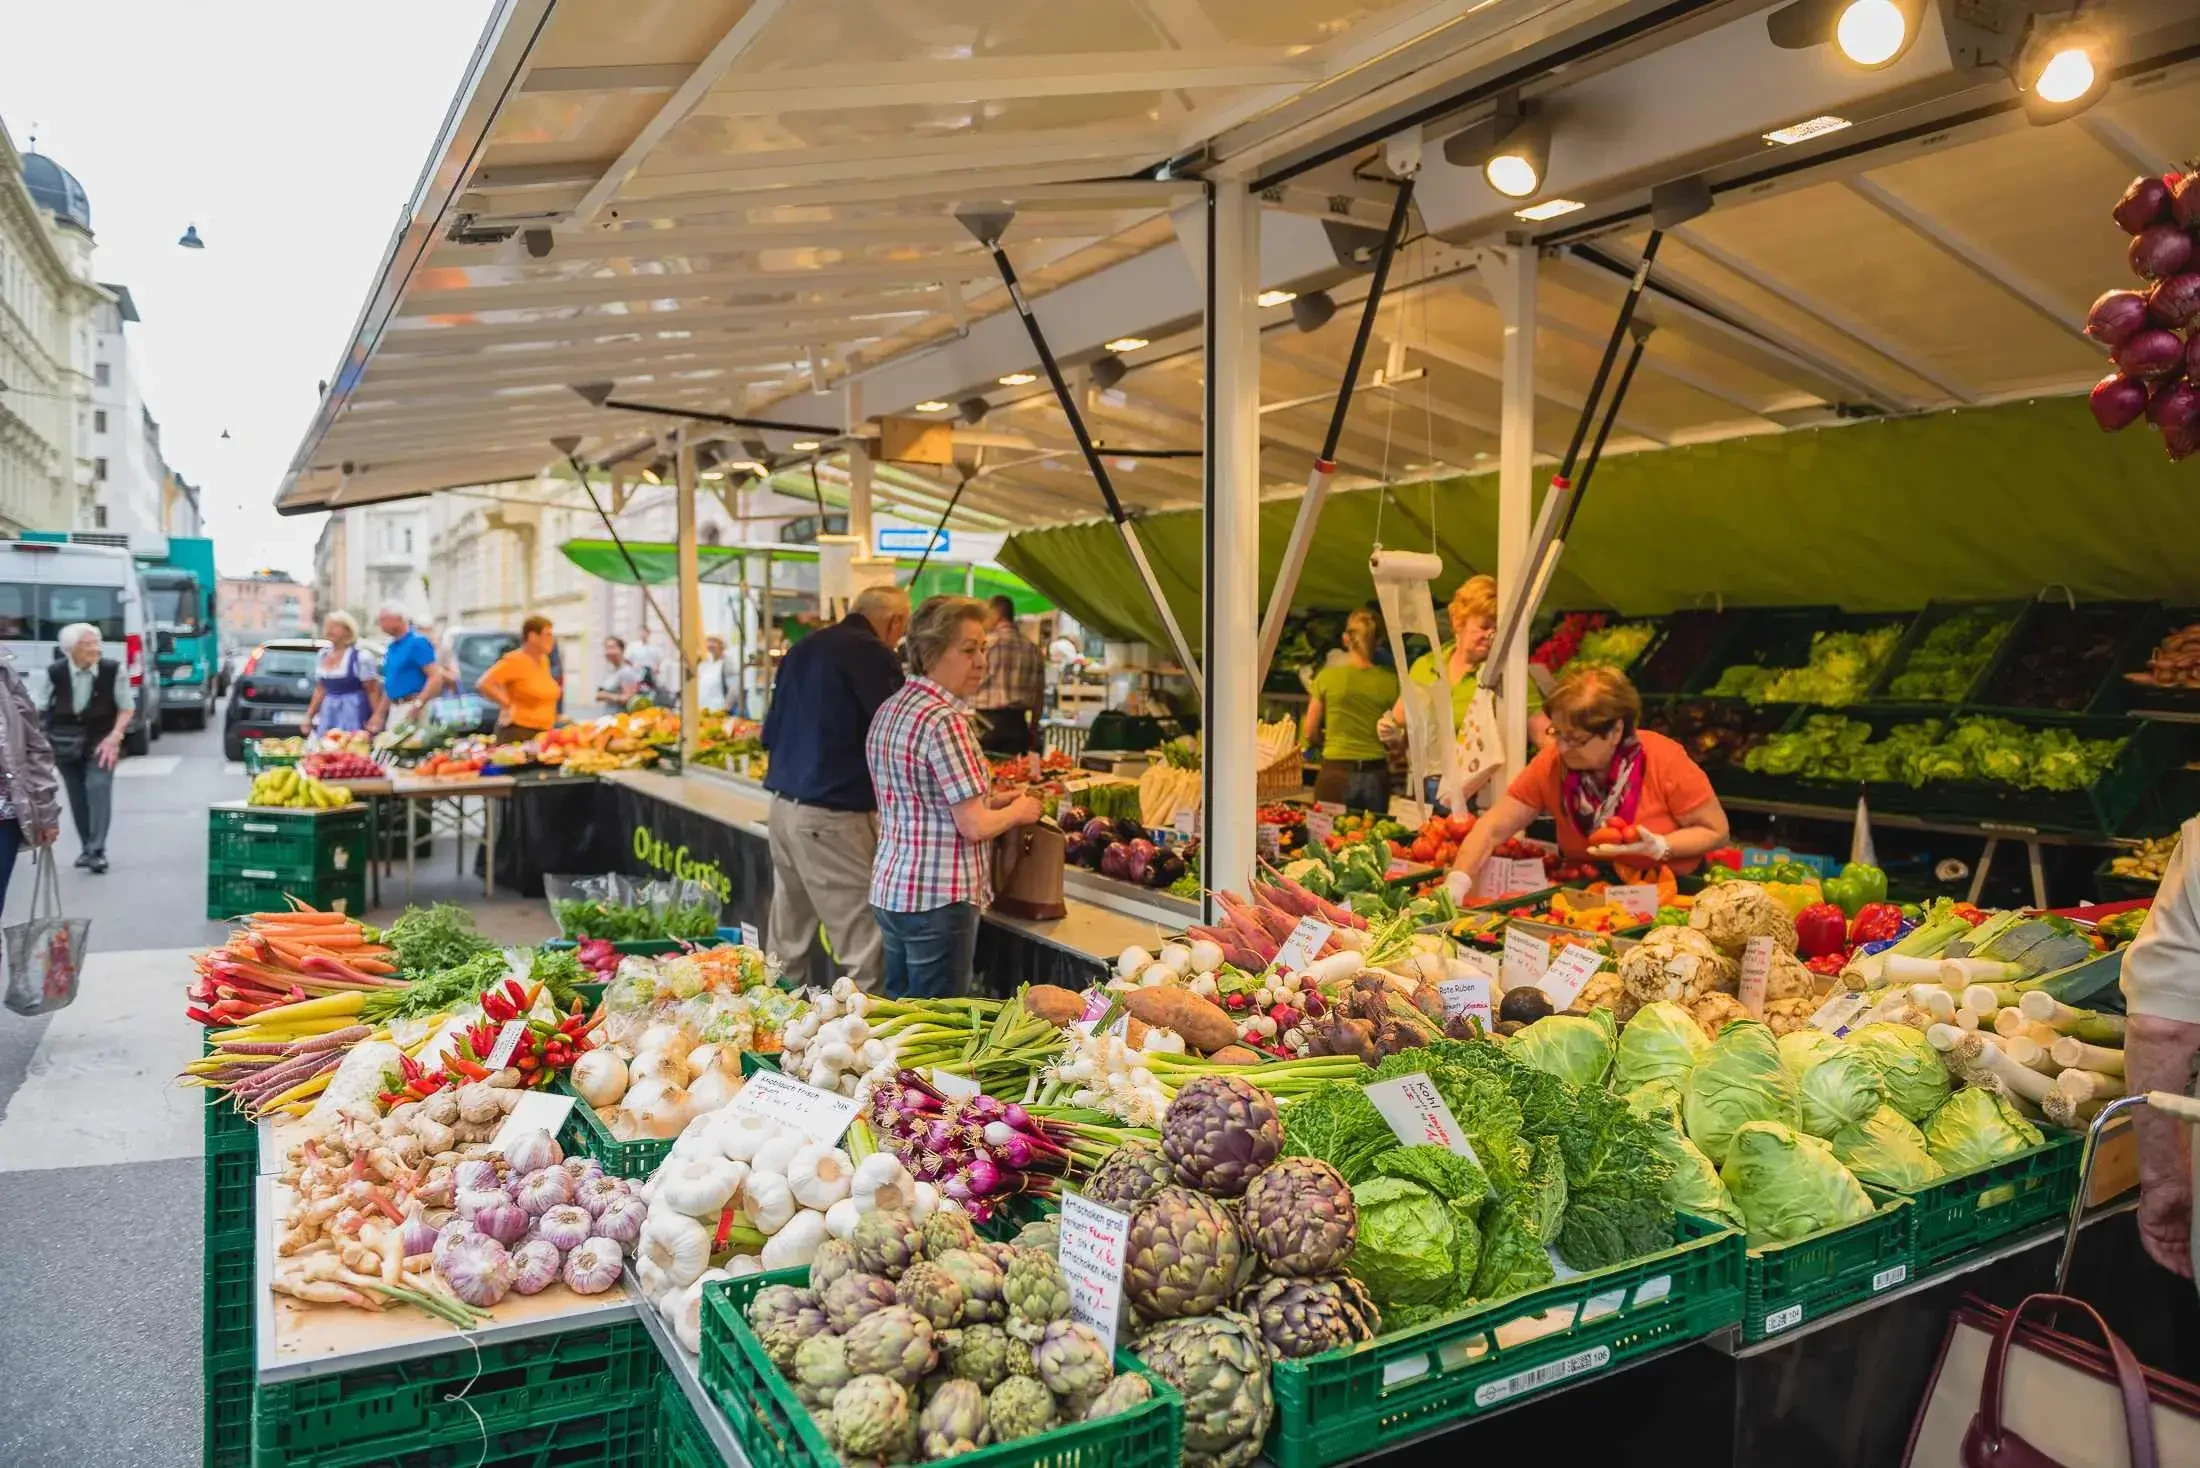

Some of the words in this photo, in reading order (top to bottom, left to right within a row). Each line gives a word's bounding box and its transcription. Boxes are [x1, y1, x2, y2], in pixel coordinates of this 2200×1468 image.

[1439, 985, 1455, 994] Rote
[1455, 983, 1475, 993] Rüben
[1417, 1082, 1440, 1109] Kohl
